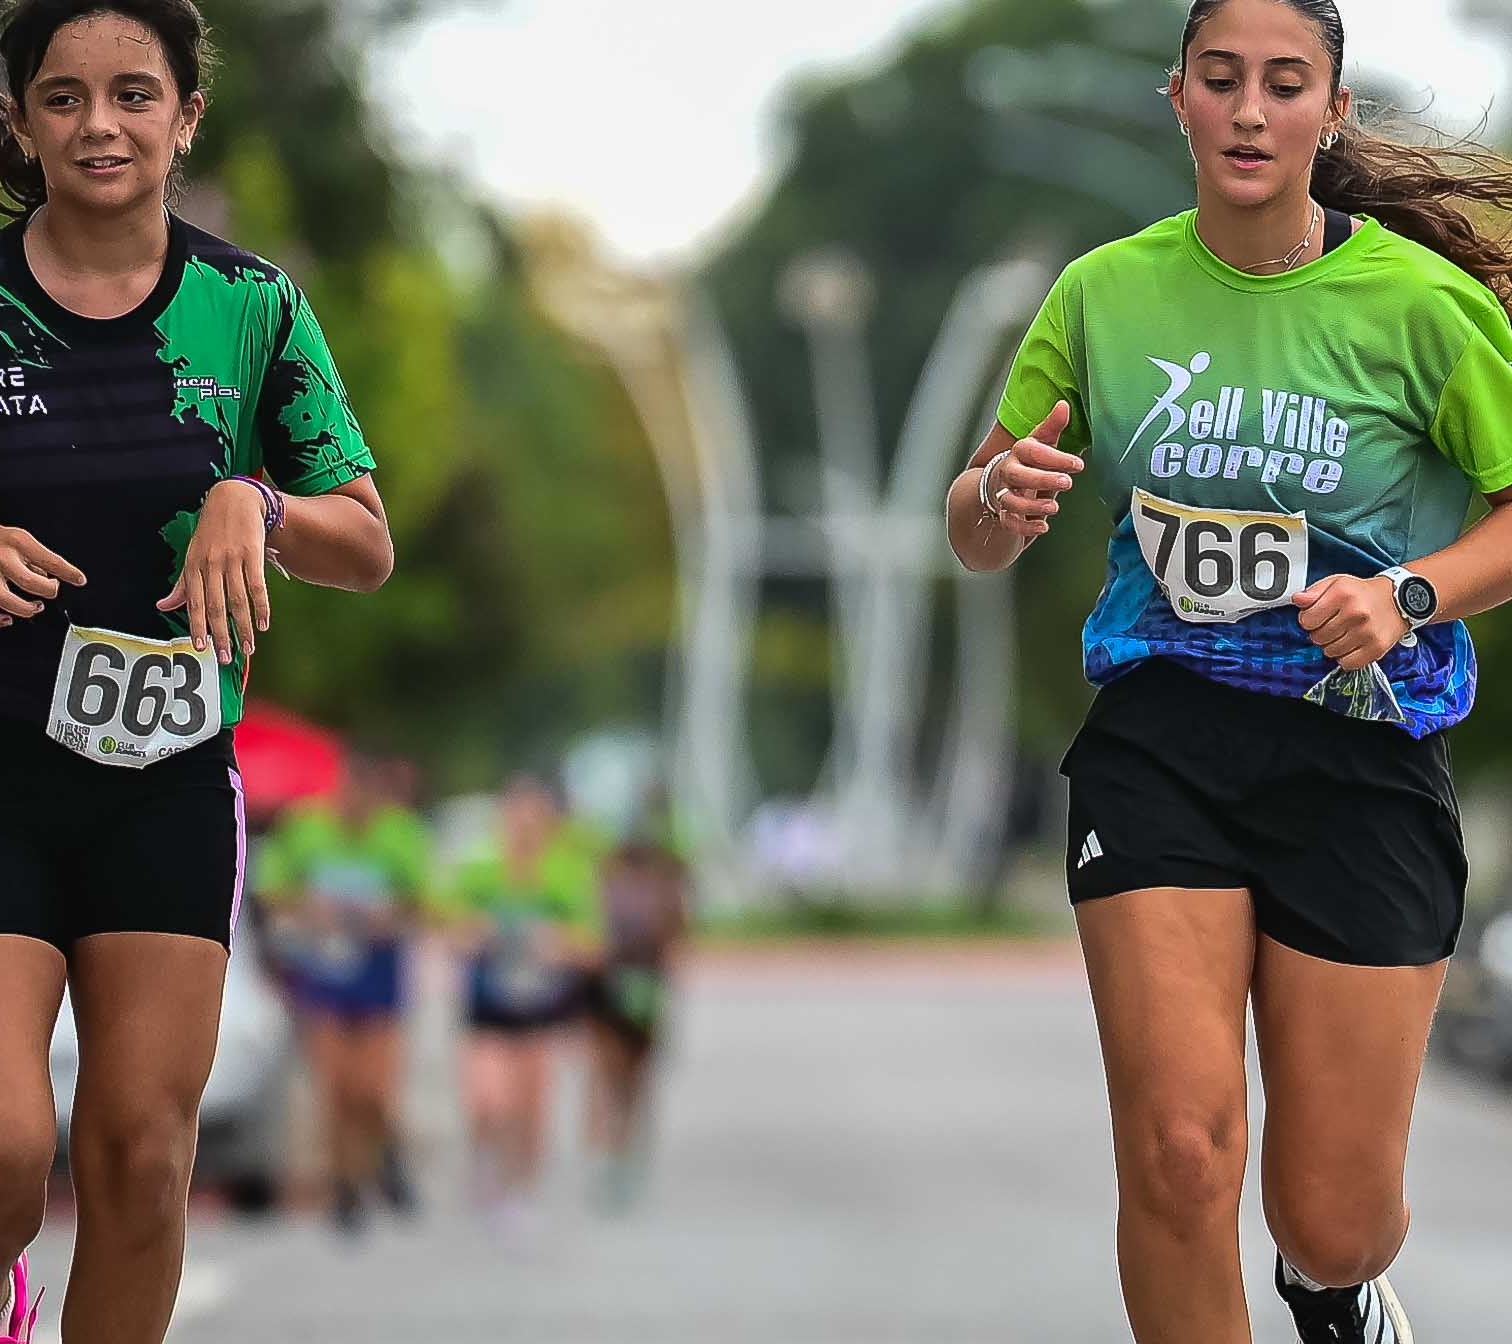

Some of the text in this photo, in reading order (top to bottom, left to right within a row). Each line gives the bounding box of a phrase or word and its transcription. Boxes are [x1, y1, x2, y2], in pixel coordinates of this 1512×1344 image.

[1261, 388, 1350, 457] Ville
[1150, 442, 1345, 494] corre
[1141, 504, 1290, 602] 766
[66, 642, 208, 737] 663
